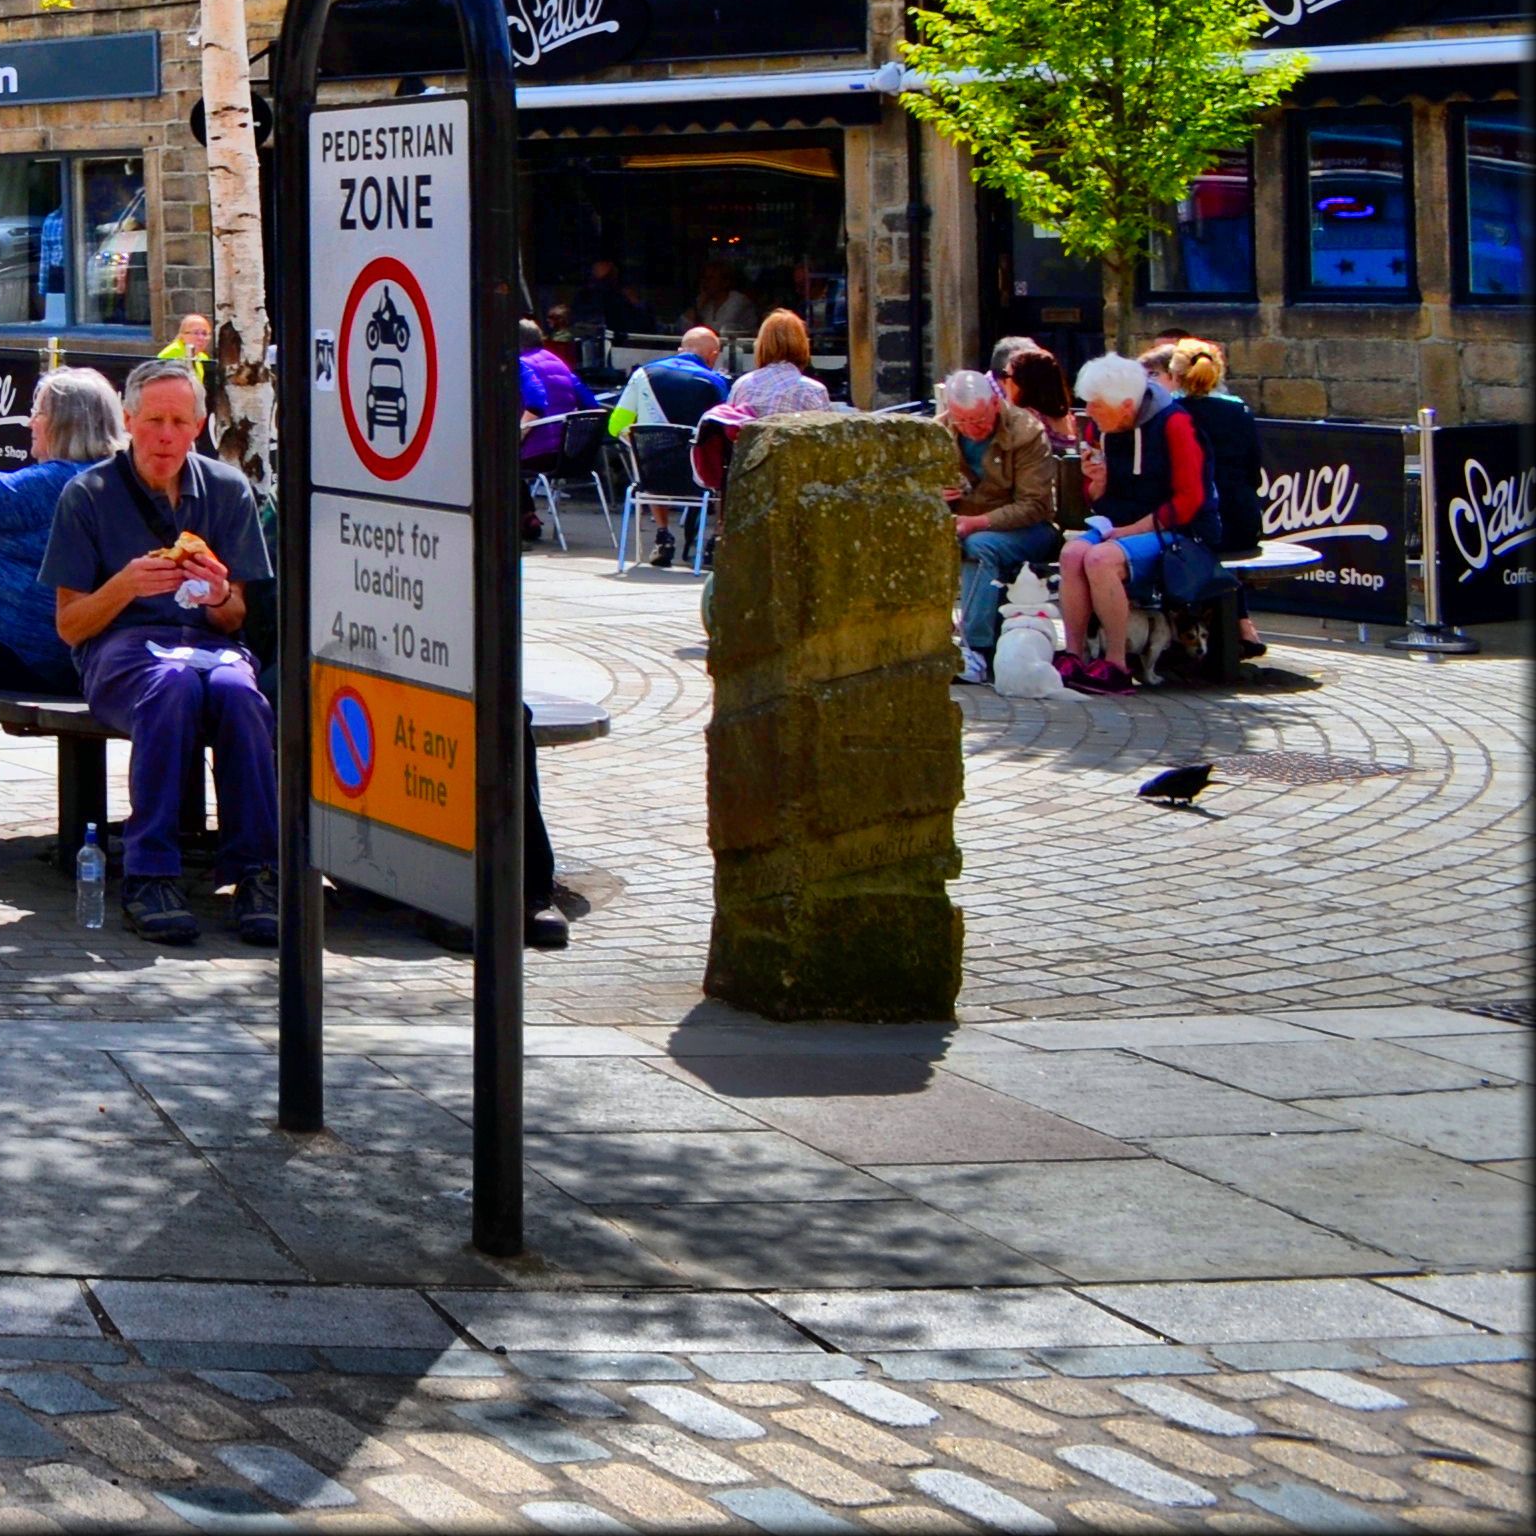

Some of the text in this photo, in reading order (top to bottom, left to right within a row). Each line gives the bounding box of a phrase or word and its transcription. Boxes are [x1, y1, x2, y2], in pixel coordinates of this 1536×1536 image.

[322, 122, 454, 163] PEDESTRIAN
[340, 174, 433, 231] ZONE
[4, 445, 28, 461] Shop
[340, 512, 439, 560] Except for
[354, 558, 424, 611] loading
[1339, 567, 1385, 592] Shop
[331, 611, 345, 643] 4
[349, 621, 377, 652] pm
[392, 622, 415, 659] 10
[420, 636, 449, 667] am
[394, 714, 459, 770] At any
[404, 763, 448, 807] time
